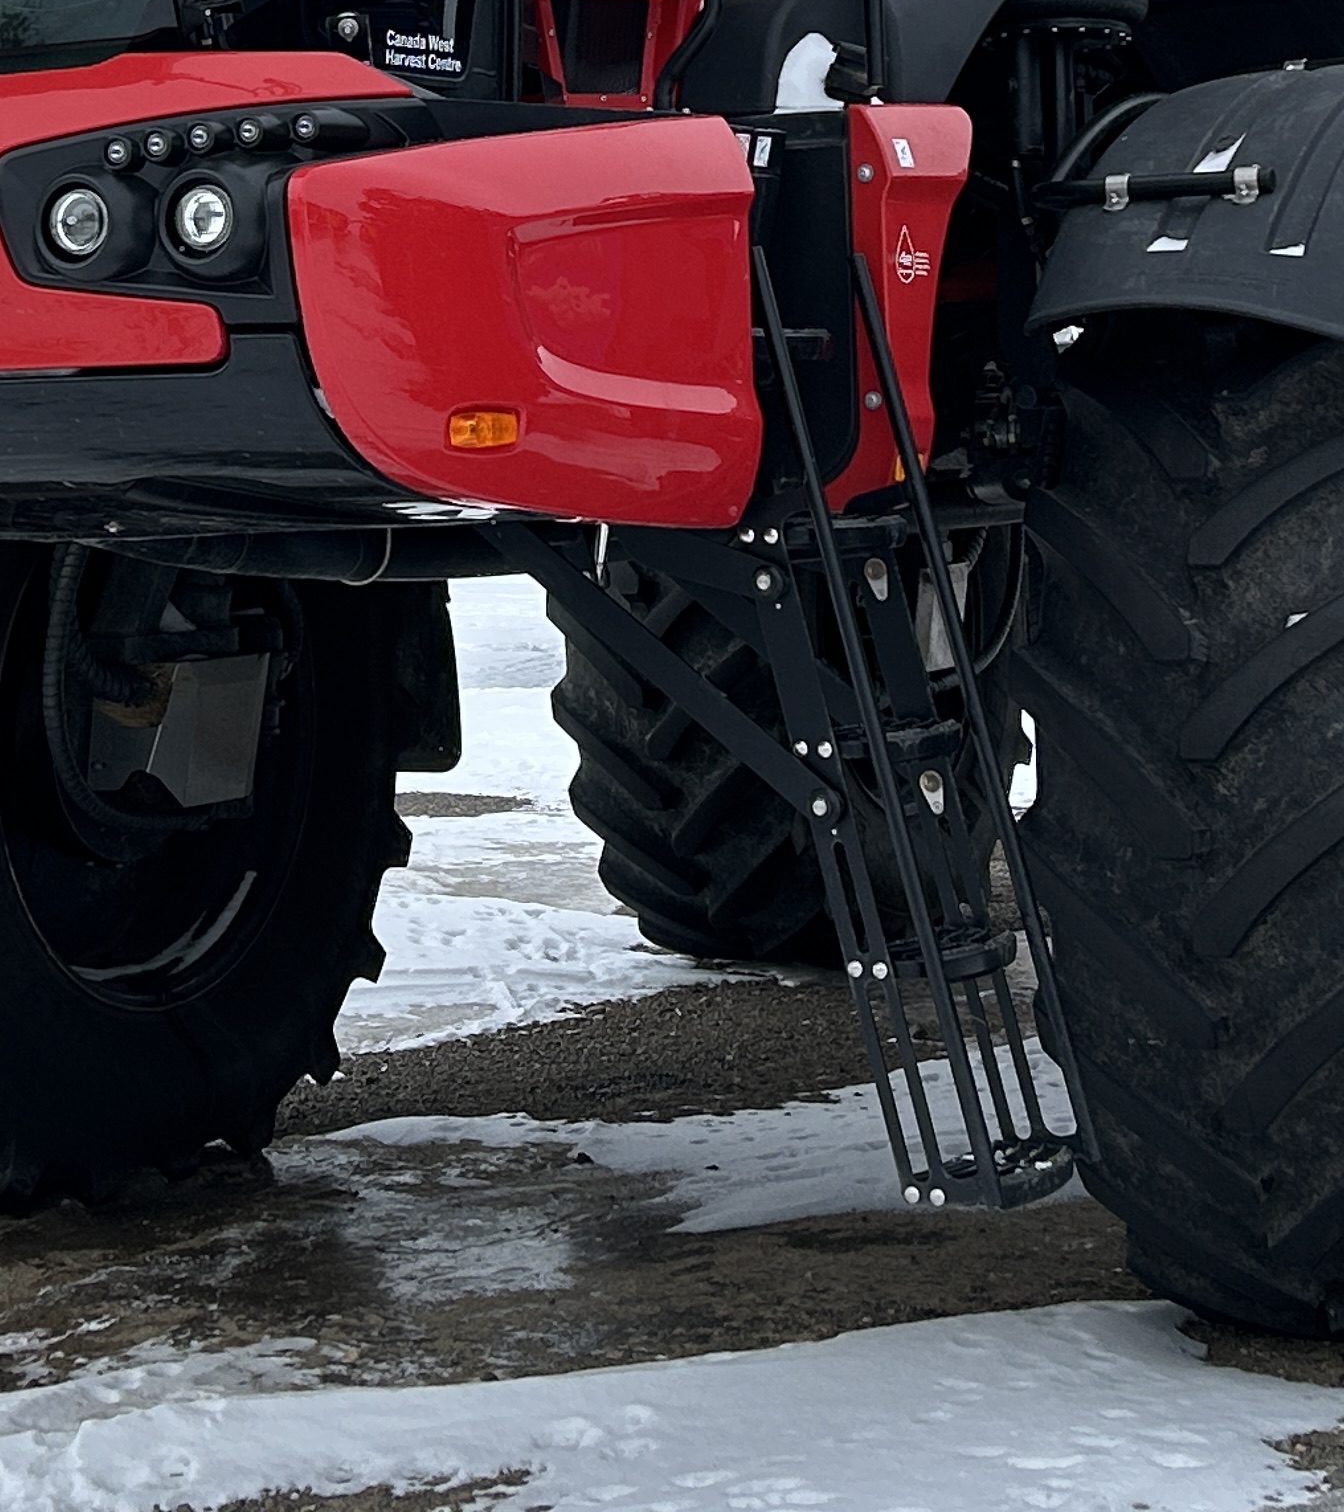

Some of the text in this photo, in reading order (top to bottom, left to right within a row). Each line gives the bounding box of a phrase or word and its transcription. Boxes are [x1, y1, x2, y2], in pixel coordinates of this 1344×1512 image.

[386, 29, 455, 54] Canada West
[385, 49, 462, 72] Harvest Centre
